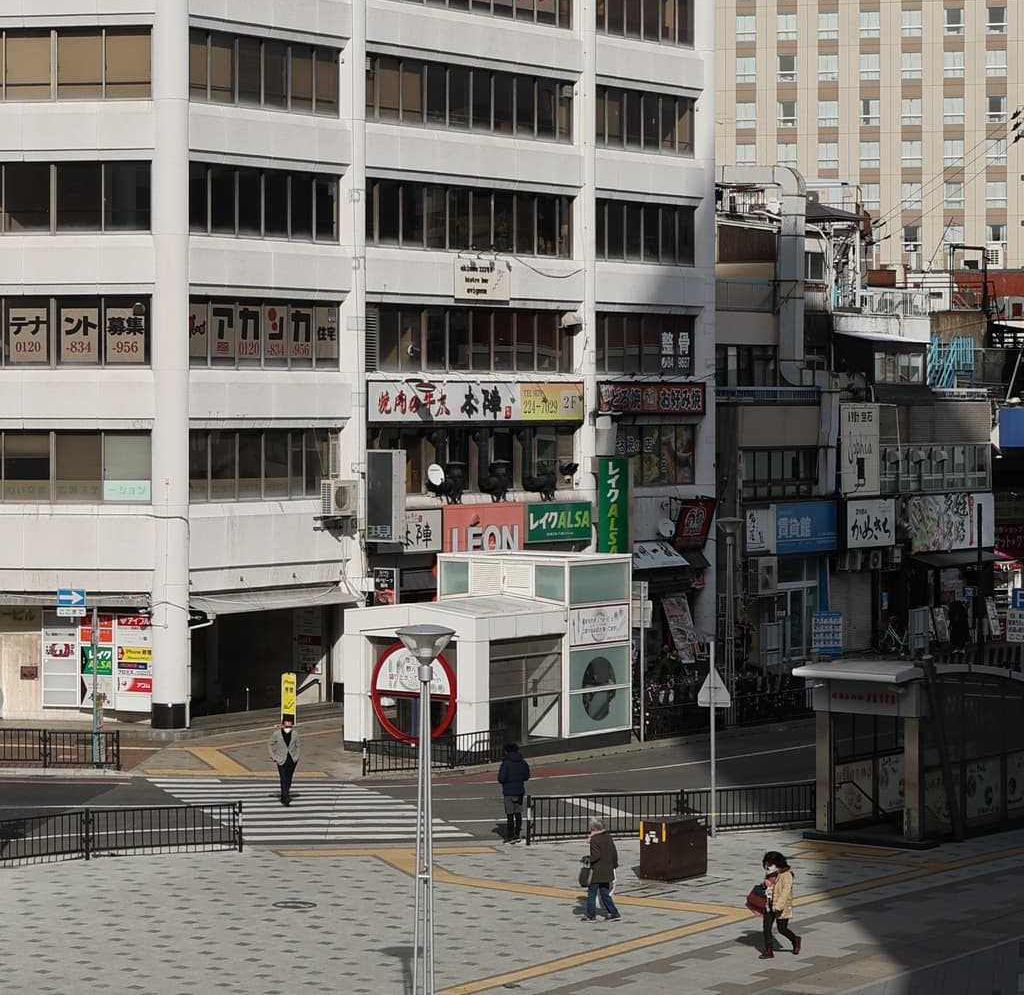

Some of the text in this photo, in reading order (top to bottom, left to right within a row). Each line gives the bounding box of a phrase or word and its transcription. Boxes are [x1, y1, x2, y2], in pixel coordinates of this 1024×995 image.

[10, 315, 145, 336] テナント募集
[318, 326, 336, 341] 住宅
[15, 341, 139, 353] 0120-834-956
[239, 342, 310, 357] 0120-834-956
[661, 331, 690, 354] 整骨
[460, 384, 502, 420] 本陣
[564, 395, 577, 409] 2F
[660, 387, 703, 411] お好み焼
[128, 617, 151, 625] アイフル
